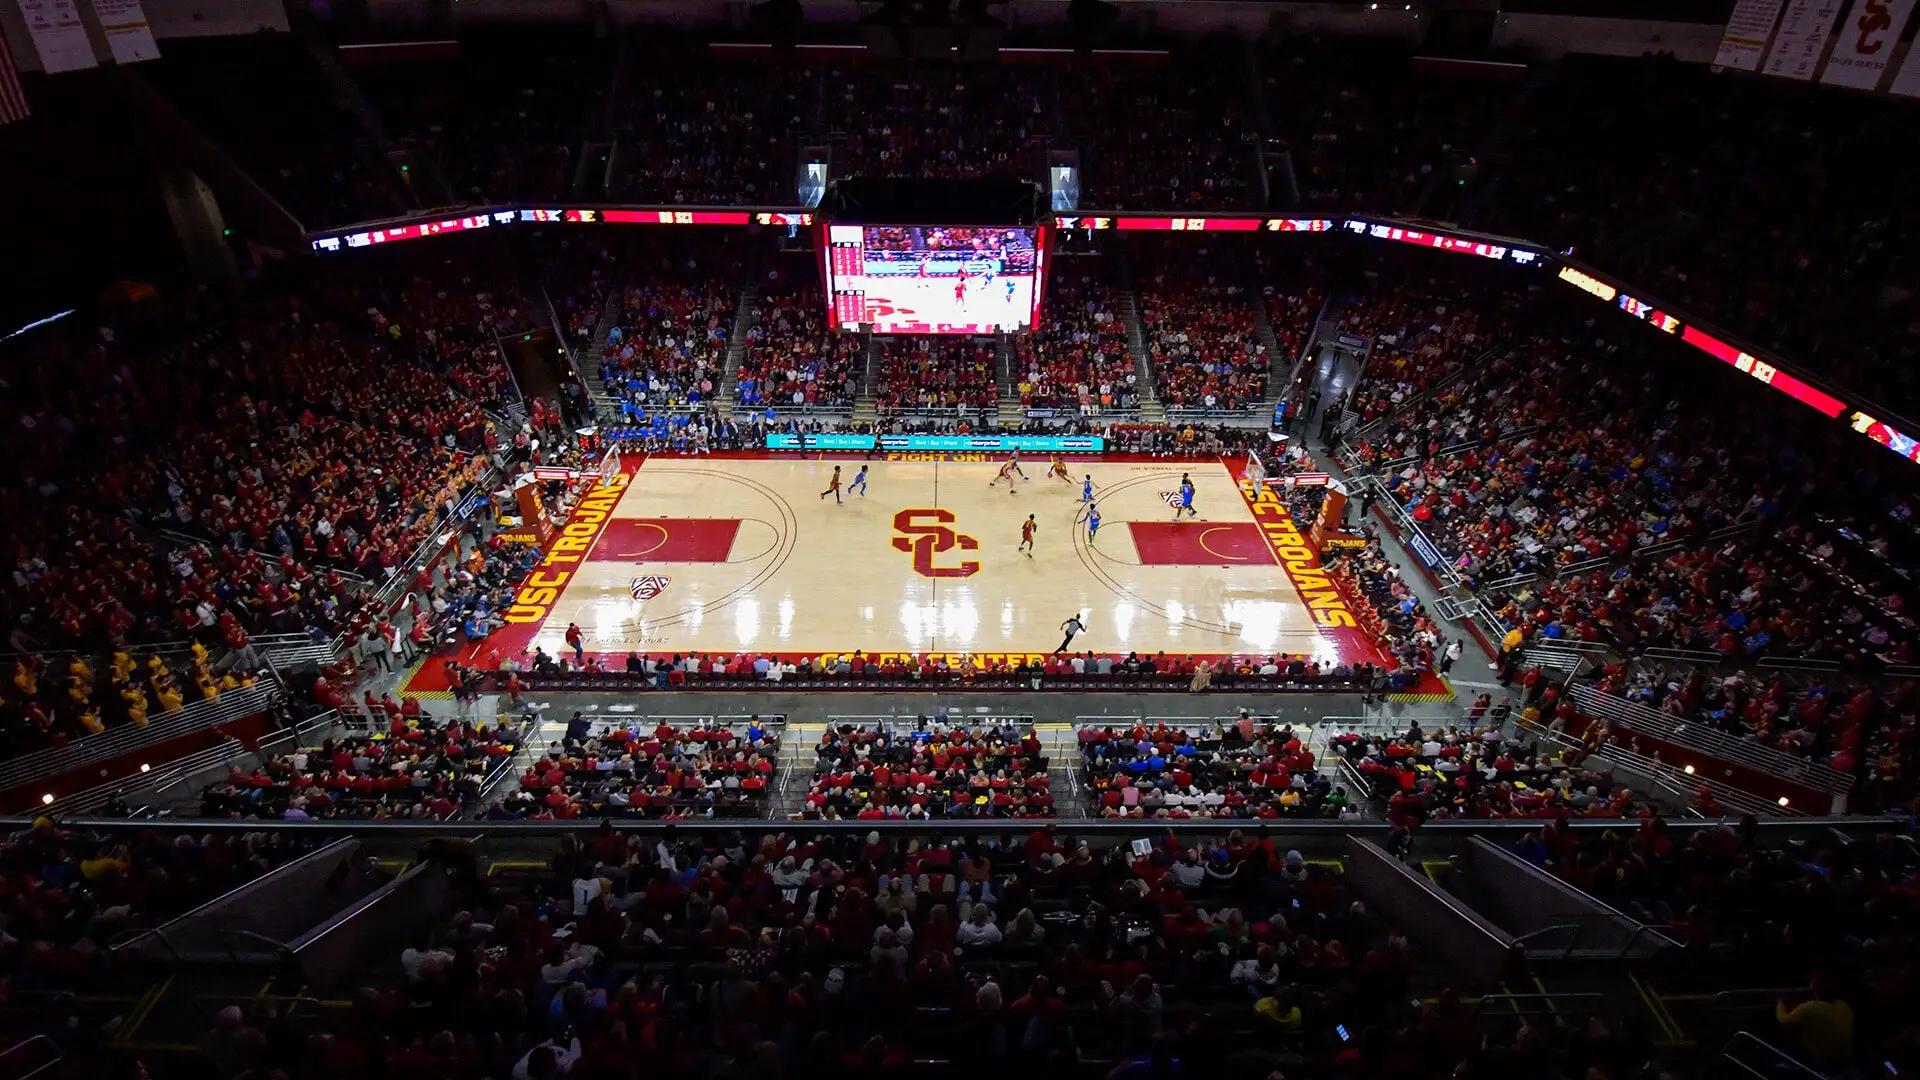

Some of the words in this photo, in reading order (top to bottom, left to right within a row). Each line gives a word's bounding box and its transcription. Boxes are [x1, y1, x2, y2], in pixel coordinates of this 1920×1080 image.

[887, 453, 948, 462] FIGHT
[953, 453, 987, 462] ON!
[505, 571, 570, 623] USC
[541, 473, 630, 566] TROJANS
[890, 508, 982, 578] SC
[1263, 519, 1357, 628] TROJANS
